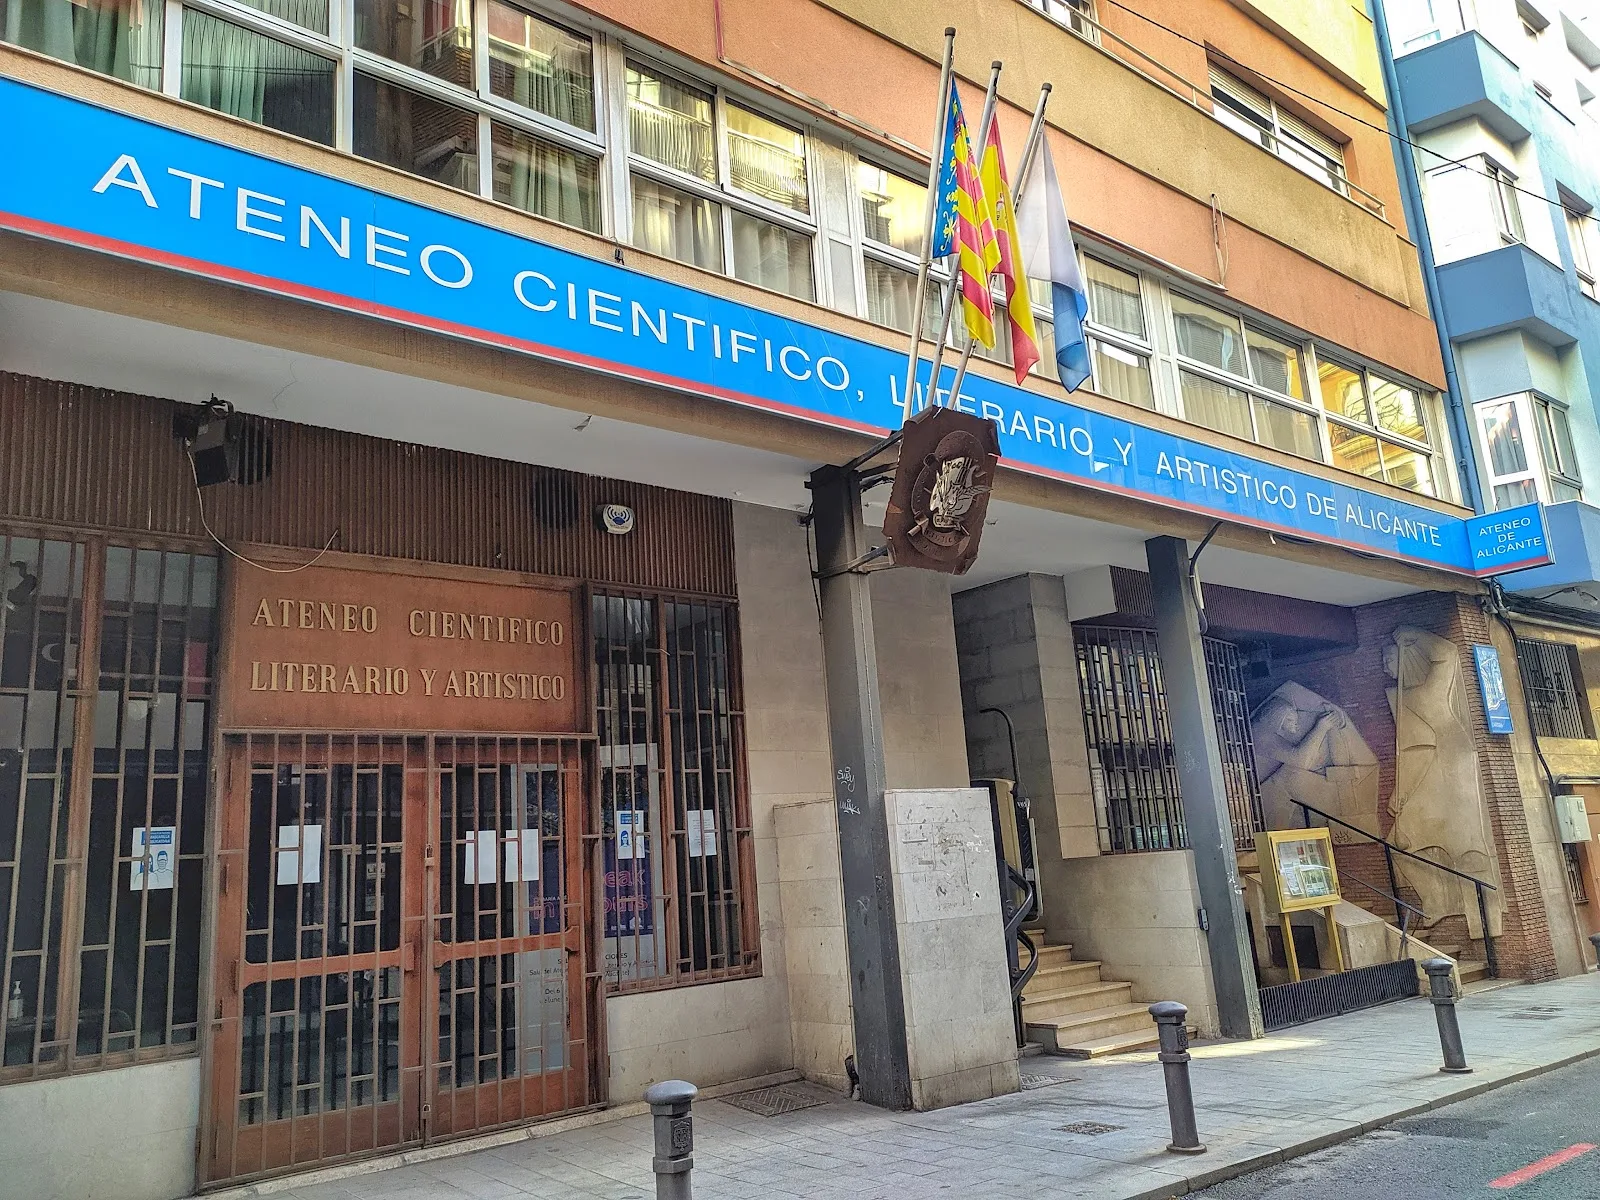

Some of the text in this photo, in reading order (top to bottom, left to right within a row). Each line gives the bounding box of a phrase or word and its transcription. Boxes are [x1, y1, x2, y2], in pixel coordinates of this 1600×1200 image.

[92, 153, 1442, 548] ATENEO CIENTIFICO, LITERARIO Y ARTISTICO DE ALICANTE
[1479, 517, 1531, 536] ATENEO
[1497, 532, 1516, 543] DE
[1477, 537, 1542, 558] ALICANTE
[252, 598, 565, 646] ATENEO CIENTIFICO
[250, 661, 566, 701] LITERARIO Y ARTISTICO
